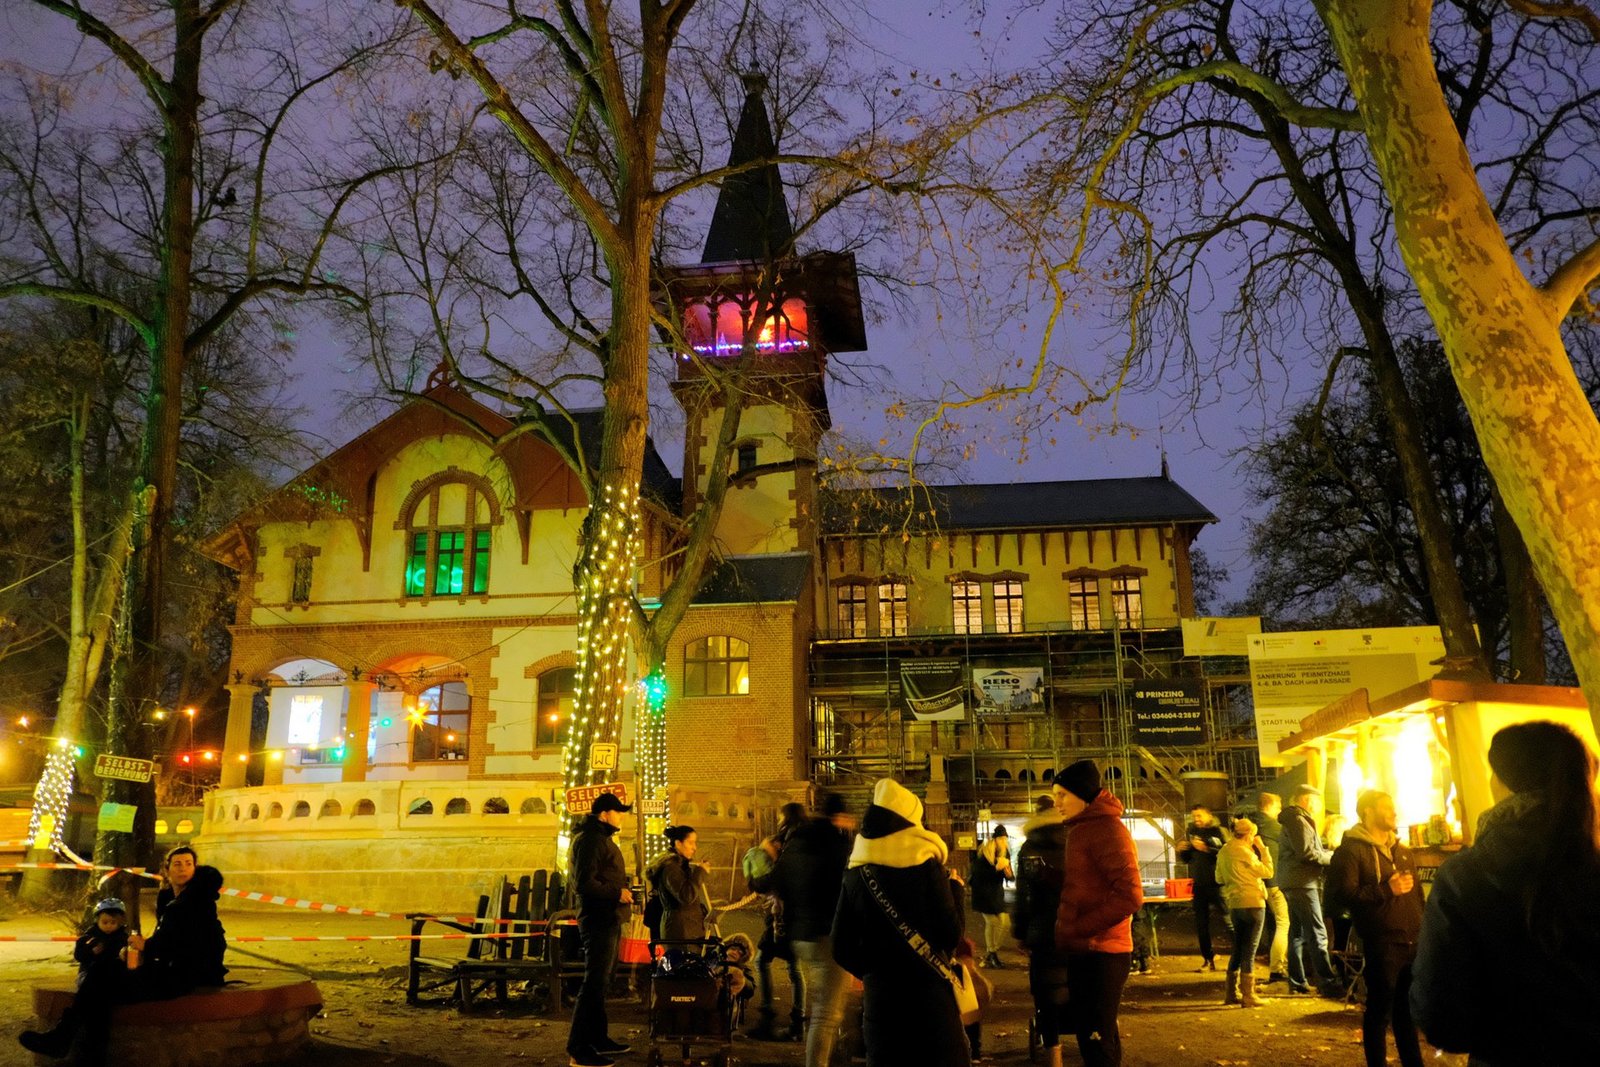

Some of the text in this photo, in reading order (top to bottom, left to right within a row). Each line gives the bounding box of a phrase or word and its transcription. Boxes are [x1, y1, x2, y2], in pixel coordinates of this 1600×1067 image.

[1256, 672, 1296, 680] SANIERUNG
[106, 758, 146, 770] SELBST-
[594, 754, 612, 766] WC
[99, 766, 147, 780] BEDIENUNG
